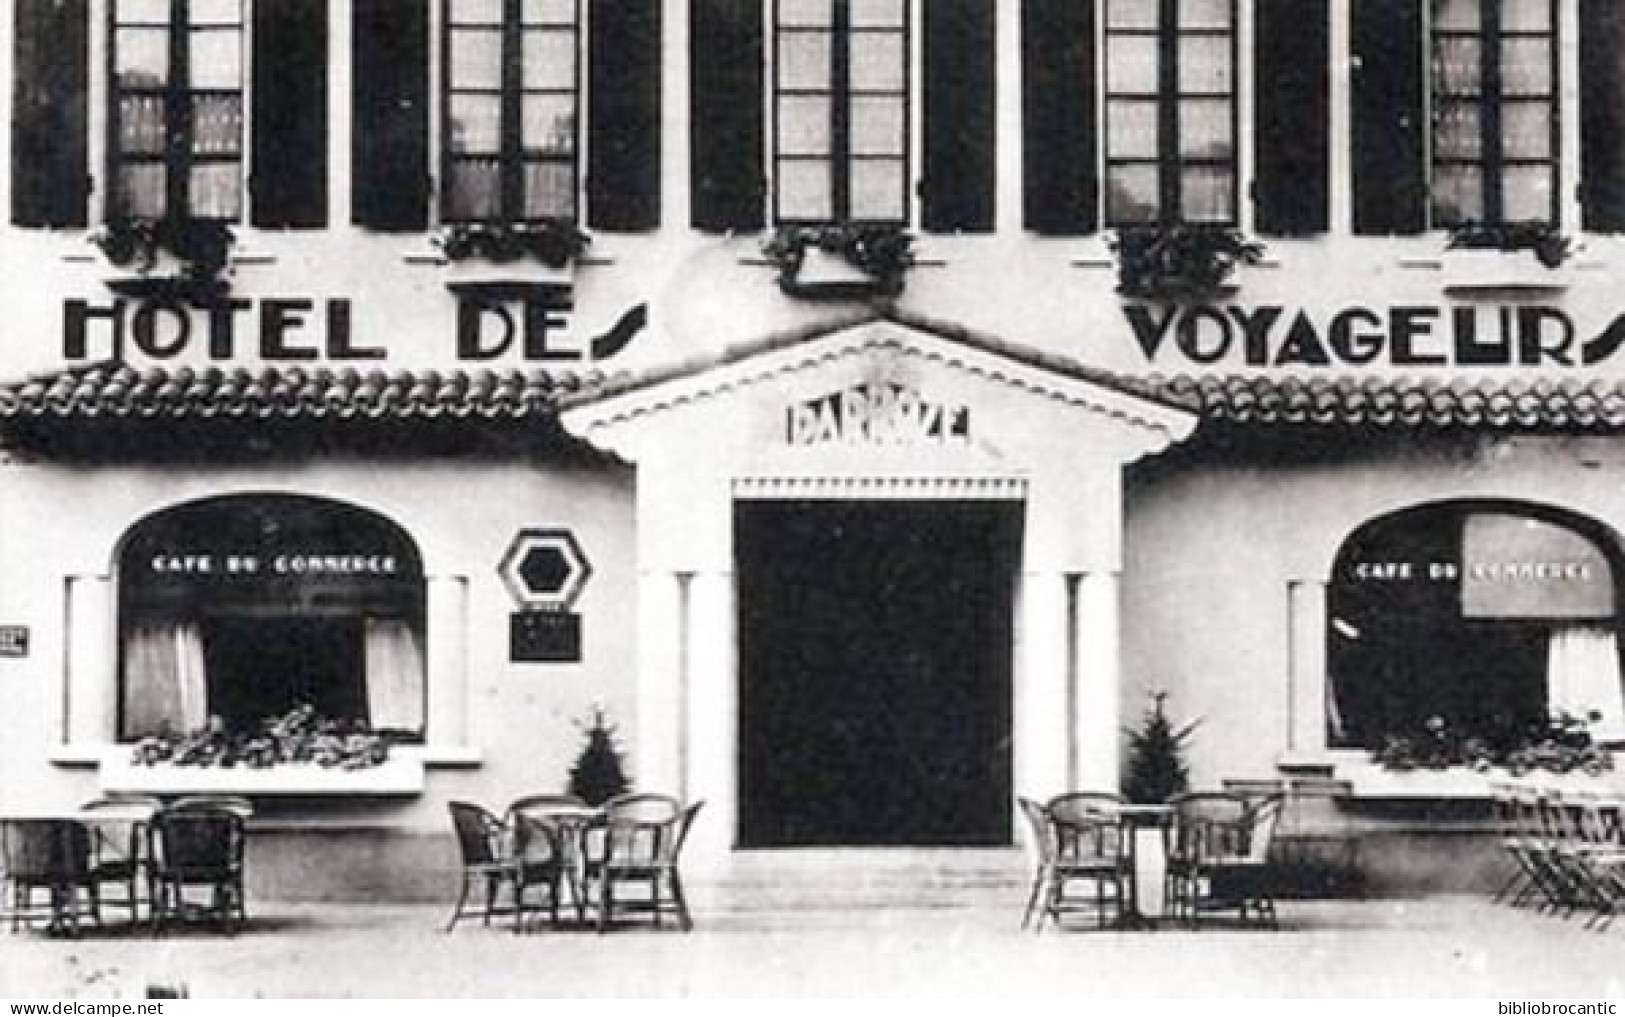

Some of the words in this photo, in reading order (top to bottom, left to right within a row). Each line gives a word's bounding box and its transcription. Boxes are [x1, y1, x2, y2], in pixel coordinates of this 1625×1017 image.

[456, 299, 648, 361] DES
[1121, 304, 1625, 366] VOYAGEURS
[274, 554, 396, 573] COMMERCE
